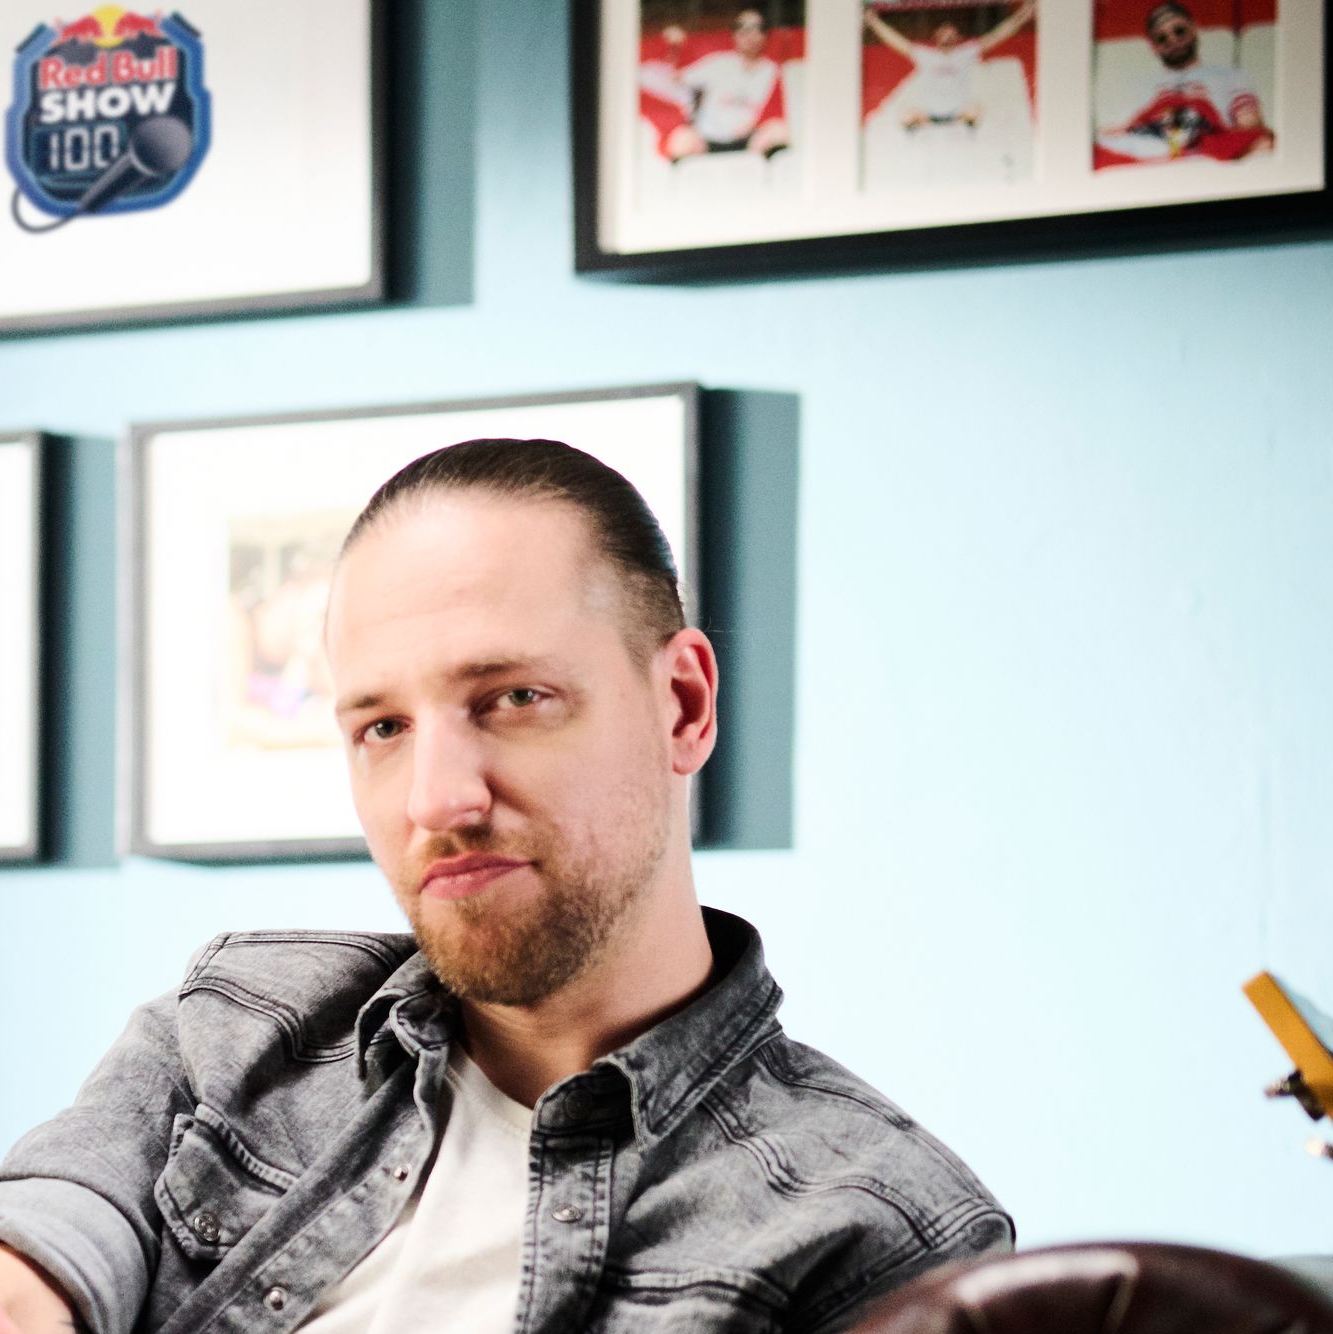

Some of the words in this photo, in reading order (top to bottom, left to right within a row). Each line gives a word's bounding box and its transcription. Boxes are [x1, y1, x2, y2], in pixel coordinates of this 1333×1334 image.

[39, 55, 106, 89] Red
[112, 47, 177, 83] Bull
[40, 83, 175, 123] SHOW
[50, 125, 119, 171] 100
